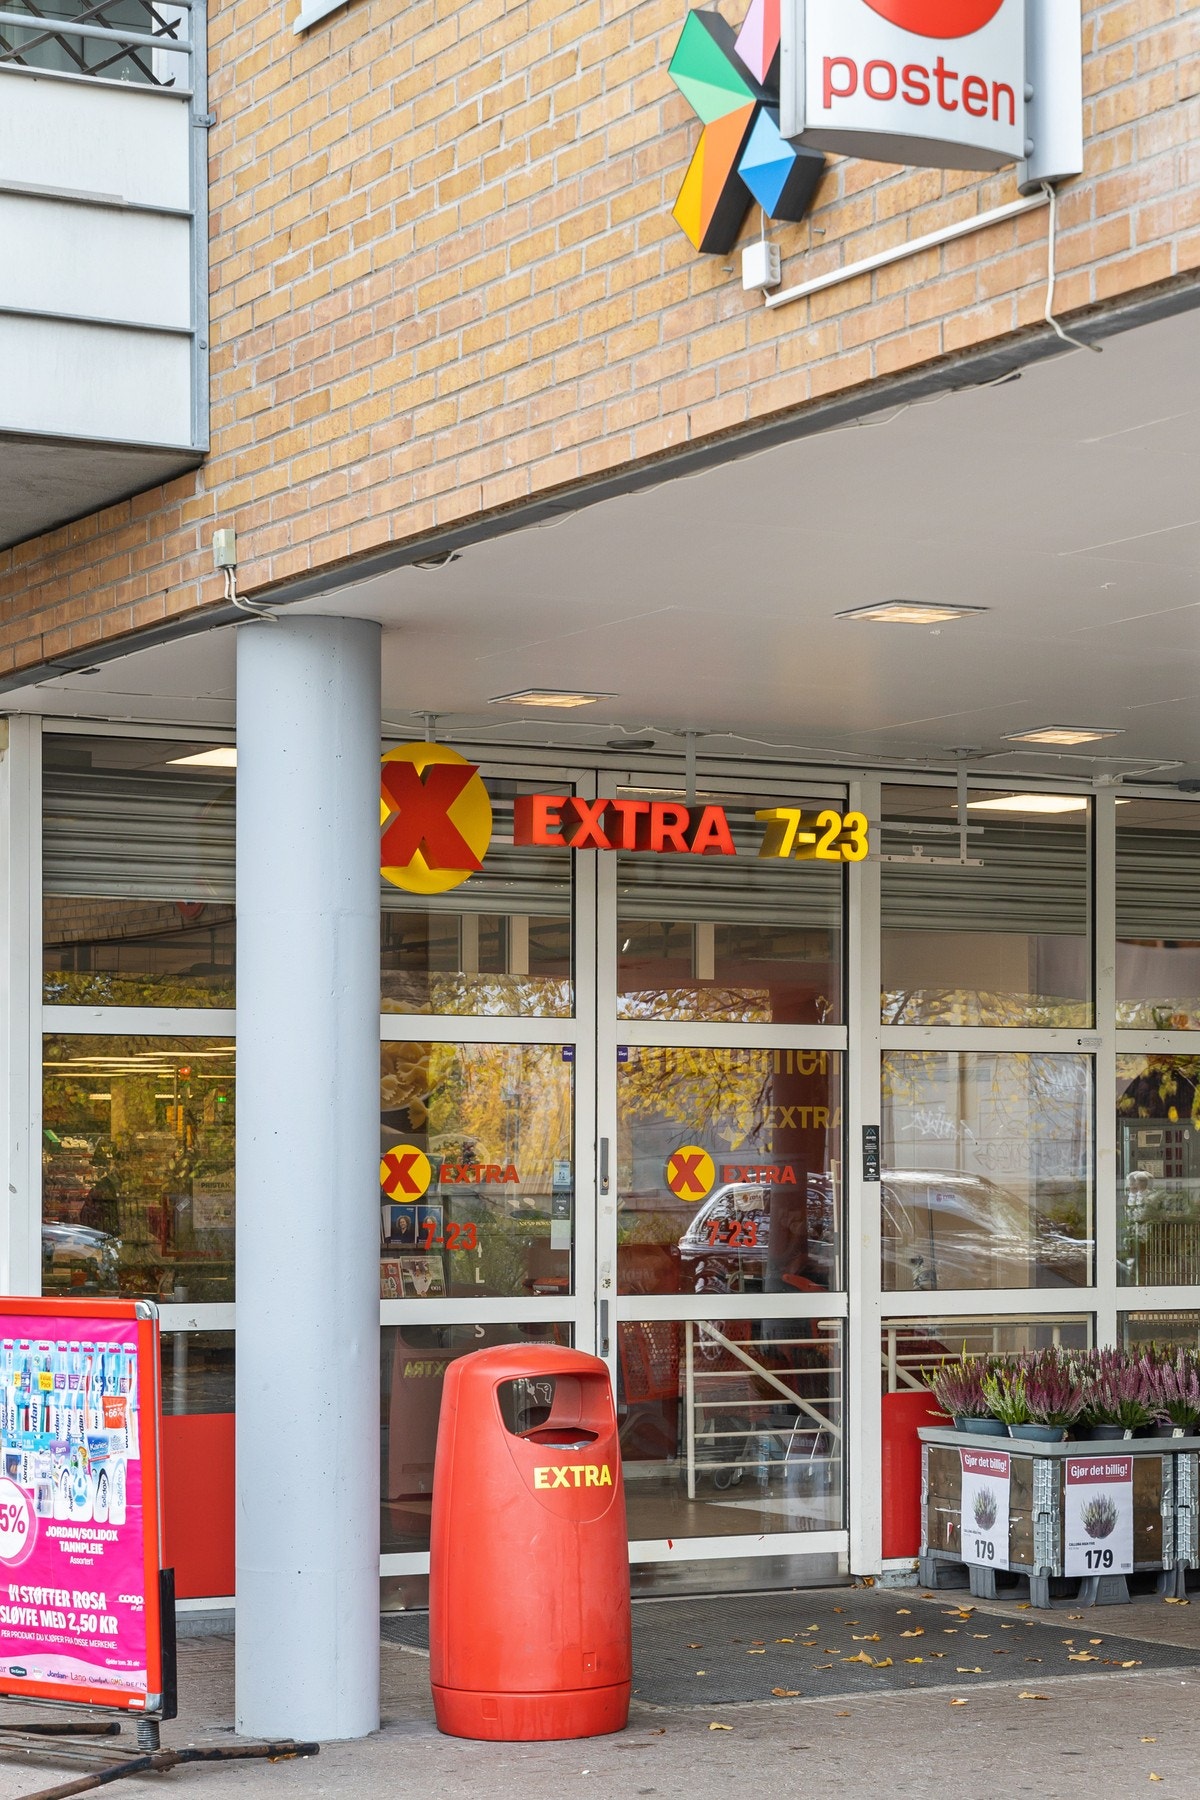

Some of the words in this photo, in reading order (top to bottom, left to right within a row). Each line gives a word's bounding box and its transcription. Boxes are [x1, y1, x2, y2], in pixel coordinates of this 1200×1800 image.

[822, 55, 1015, 127] posten
[519, 794, 737, 856] EXTRA
[757, 808, 869, 862] 7-23
[381, 1153, 422, 1194] X
[440, 1164, 520, 1184] EXTRA
[669, 1153, 706, 1193] X
[722, 1164, 797, 1184] EXTRA
[422, 1222, 477, 1250] 7-23
[706, 1221, 757, 1248] 7-23
[964, 1454, 977, 1467] Gjør
[978, 1456, 989, 1468] det
[990, 1458, 1007, 1473] billig!
[1071, 1465, 1089, 1479] Gjør
[1090, 1465, 1104, 1476] det
[1105, 1463, 1128, 1477] billig!
[533, 1464, 613, 1489] EXTRA
[45, 1525, 119, 1542] JORDAN/SOLIDOX
[59, 1540, 104, 1555] TANNPLEIE
[975, 1539, 995, 1561] 179
[69, 1555, 94, 1566] Assortert
[1085, 1549, 1114, 1569] 179
[8, 1583, 20, 1602] VI
[20, 1585, 71, 1607] STØTTER
[72, 1590, 107, 1611] ROSA
[118, 1594, 144, 1605] coop
[0, 1604, 39, 1626] SLØYFE
[40, 1609, 67, 1629] MED
[67, 1612, 97, 1635] 2,50
[99, 1615, 119, 1635] KR
[47, 1670, 67, 1679] Jordan
